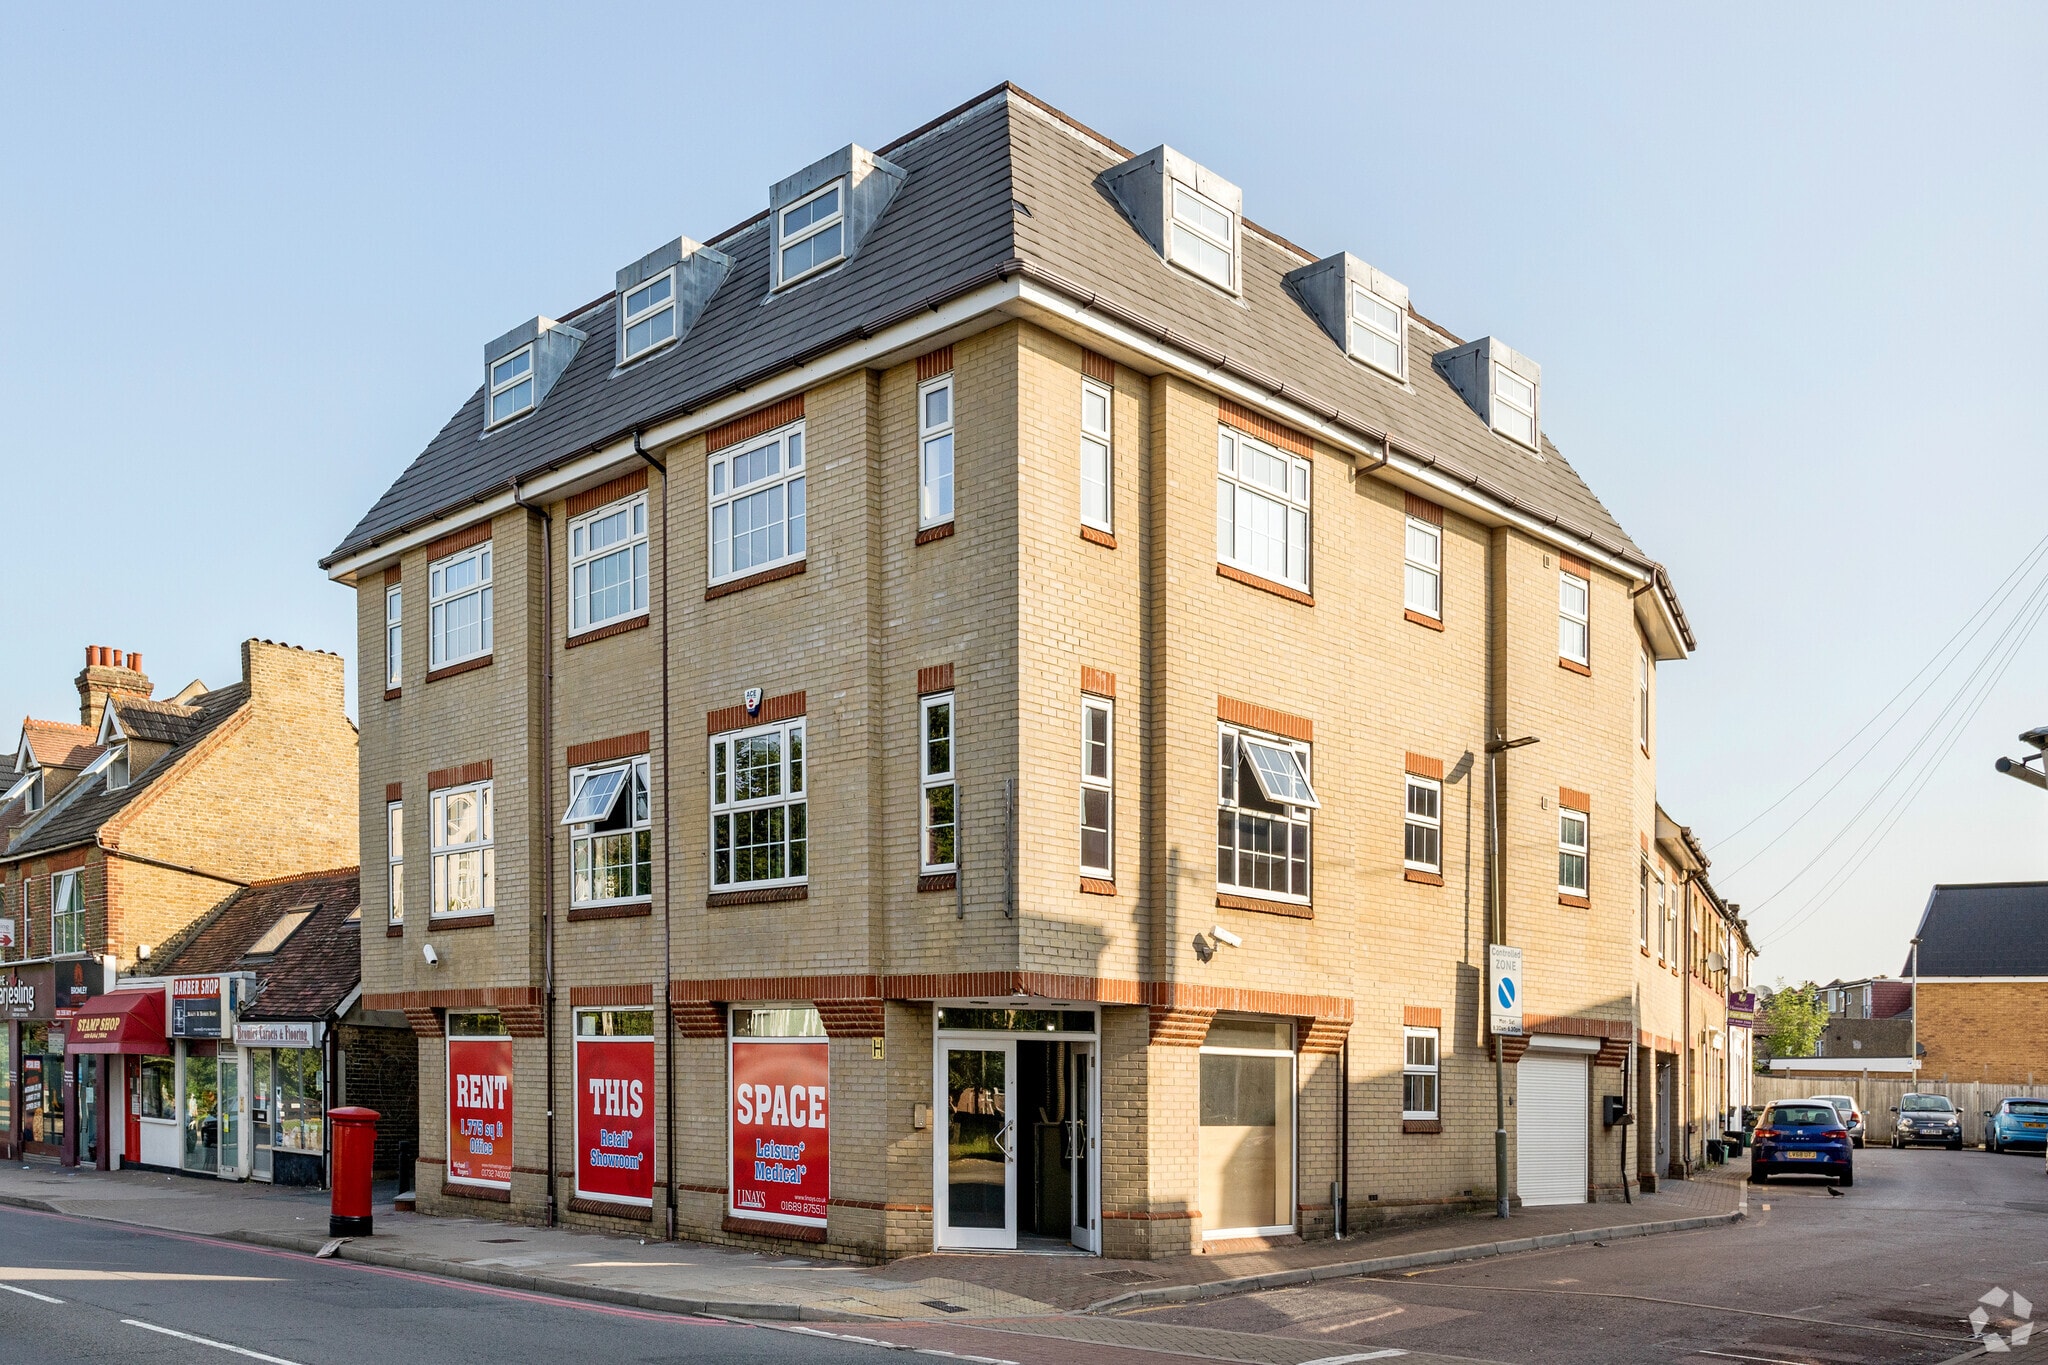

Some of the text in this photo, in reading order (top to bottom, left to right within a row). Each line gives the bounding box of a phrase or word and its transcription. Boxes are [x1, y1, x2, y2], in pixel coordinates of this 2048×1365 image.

[1491, 947, 1521, 960] Controlled
[1495, 960, 1517, 972] ZONE
[70, 986, 88, 995] BROMLEY
[174, 979, 219, 996] BARBER SHOP
[77, 1017, 121, 1031] STAMP SHOP
[260, 1025, 278, 1041] Carpets
[279, 1029, 284, 1040] &
[285, 1025, 308, 1042] Flooring
[873, 1039, 883, 1057] H
[456, 1074, 508, 1110] RENT
[589, 1078, 643, 1118] THIS
[737, 1083, 826, 1128] SPACE
[460, 1118, 503, 1141] 1,775 sq ft
[469, 1137, 493, 1156] Office
[738, 1189, 766, 1209] LINAYS
[794, 1195, 826, 1204] www.linays.co.uk
[781, 1201, 826, 1215] 01689 875511
